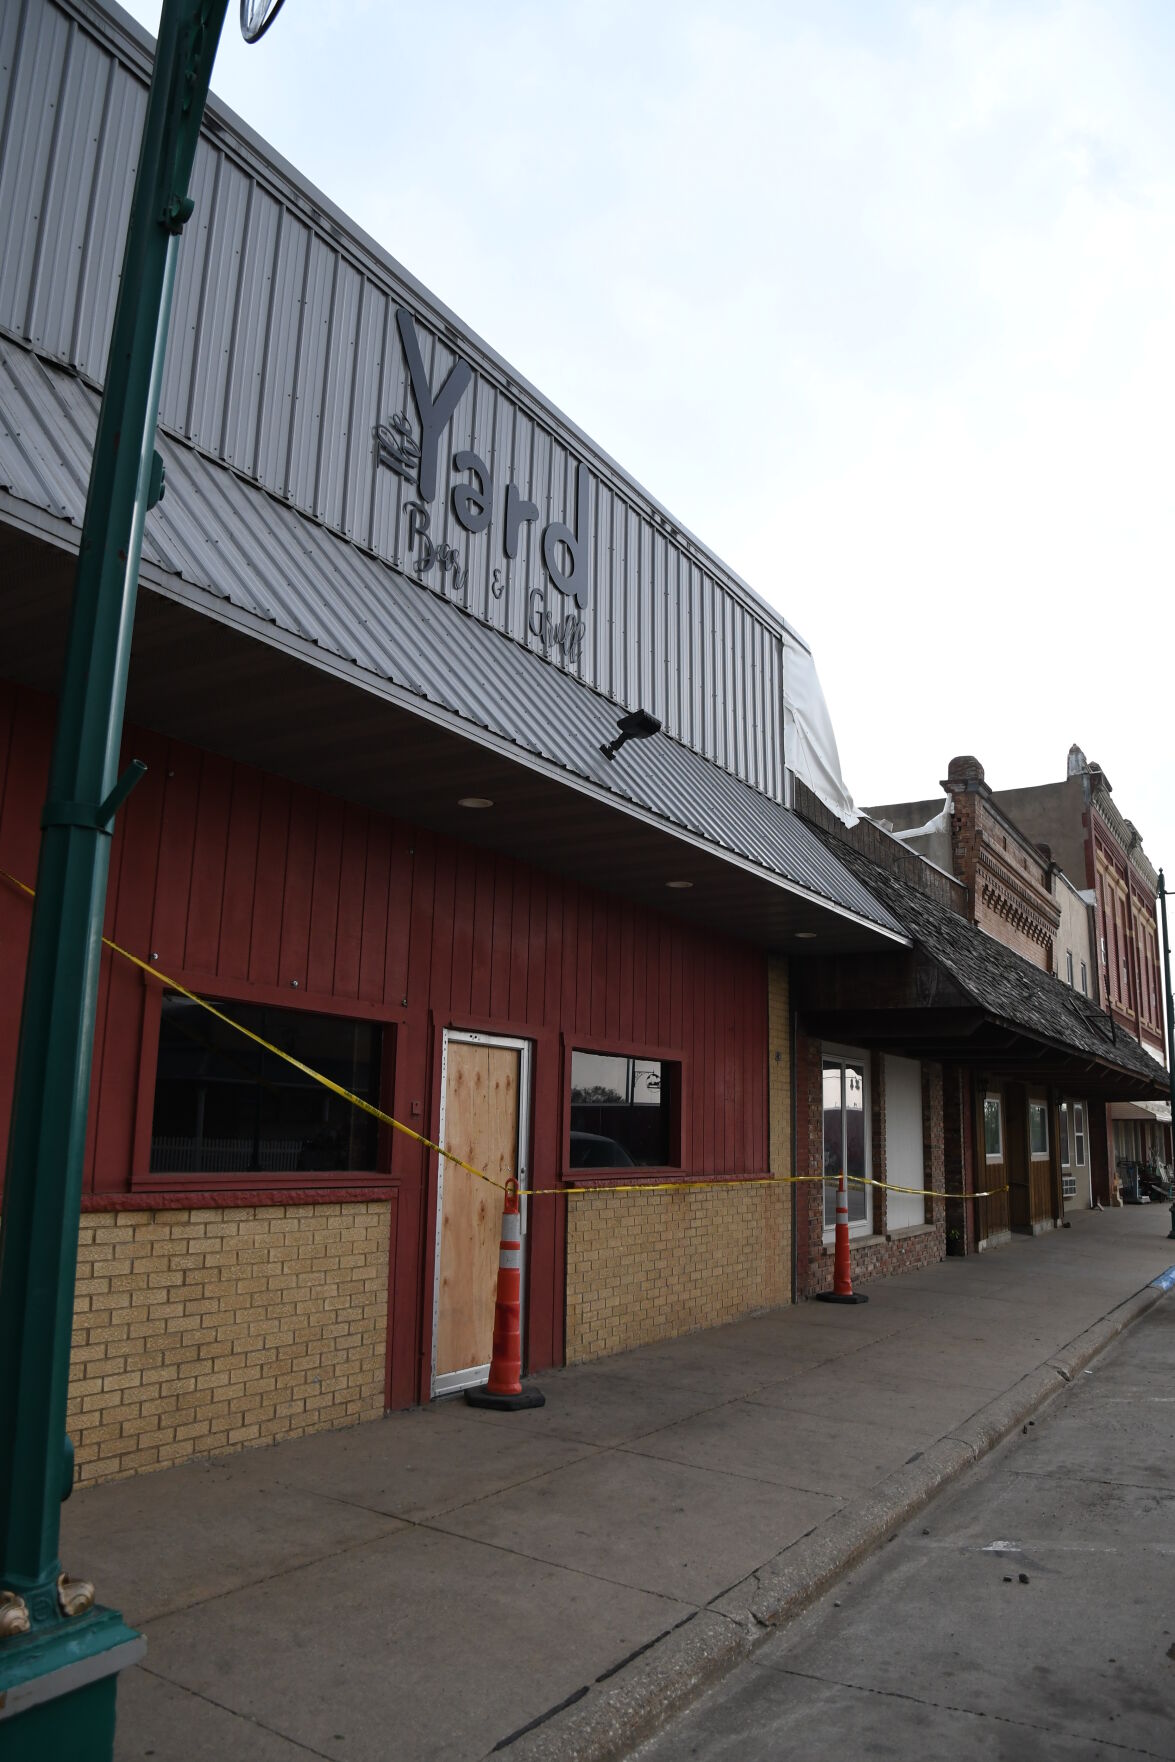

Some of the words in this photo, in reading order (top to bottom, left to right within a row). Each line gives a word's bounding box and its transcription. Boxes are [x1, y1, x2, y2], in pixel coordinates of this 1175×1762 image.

[376, 410, 421, 486] The
[396, 307, 588, 610] Yard
[403, 501, 468, 590] Bar
[492, 568, 504, 599] &
[529, 588, 586, 663] Grill
